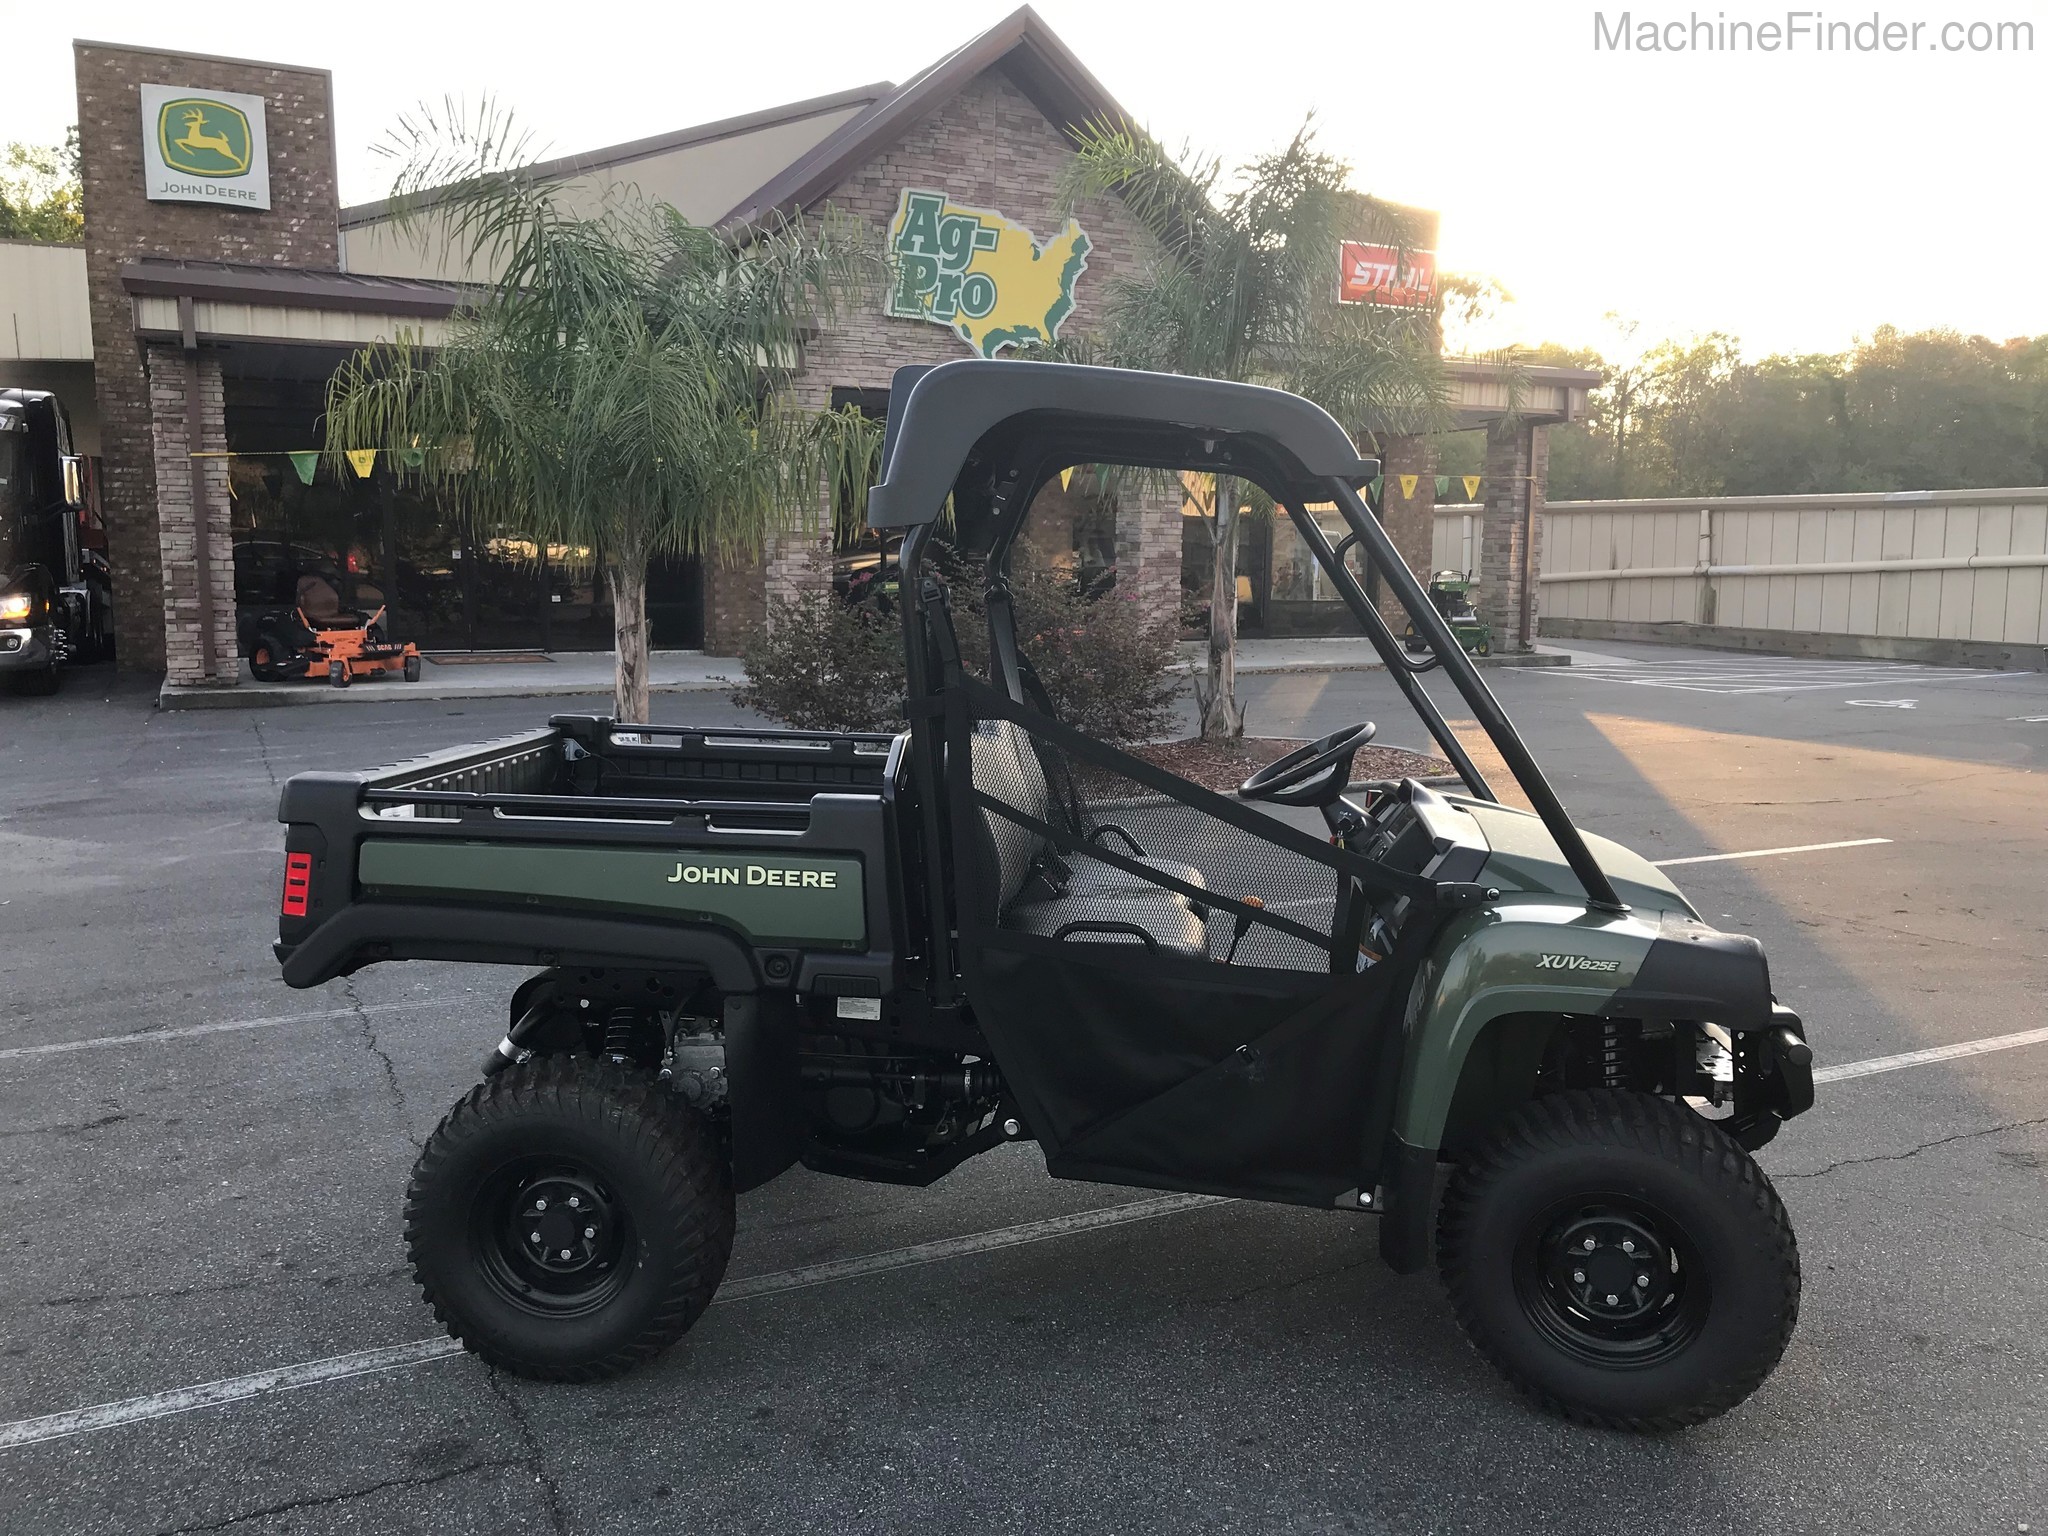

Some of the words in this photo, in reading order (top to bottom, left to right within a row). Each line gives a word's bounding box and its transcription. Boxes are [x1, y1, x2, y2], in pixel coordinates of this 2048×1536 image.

[160, 182, 203, 195] JOHN
[205, 184, 257, 201] DEERE
[894, 254, 998, 320] Pro
[667, 862, 740, 886] JOHN
[746, 865, 838, 889] DEERE
[1535, 954, 1620, 972] XUV825E
